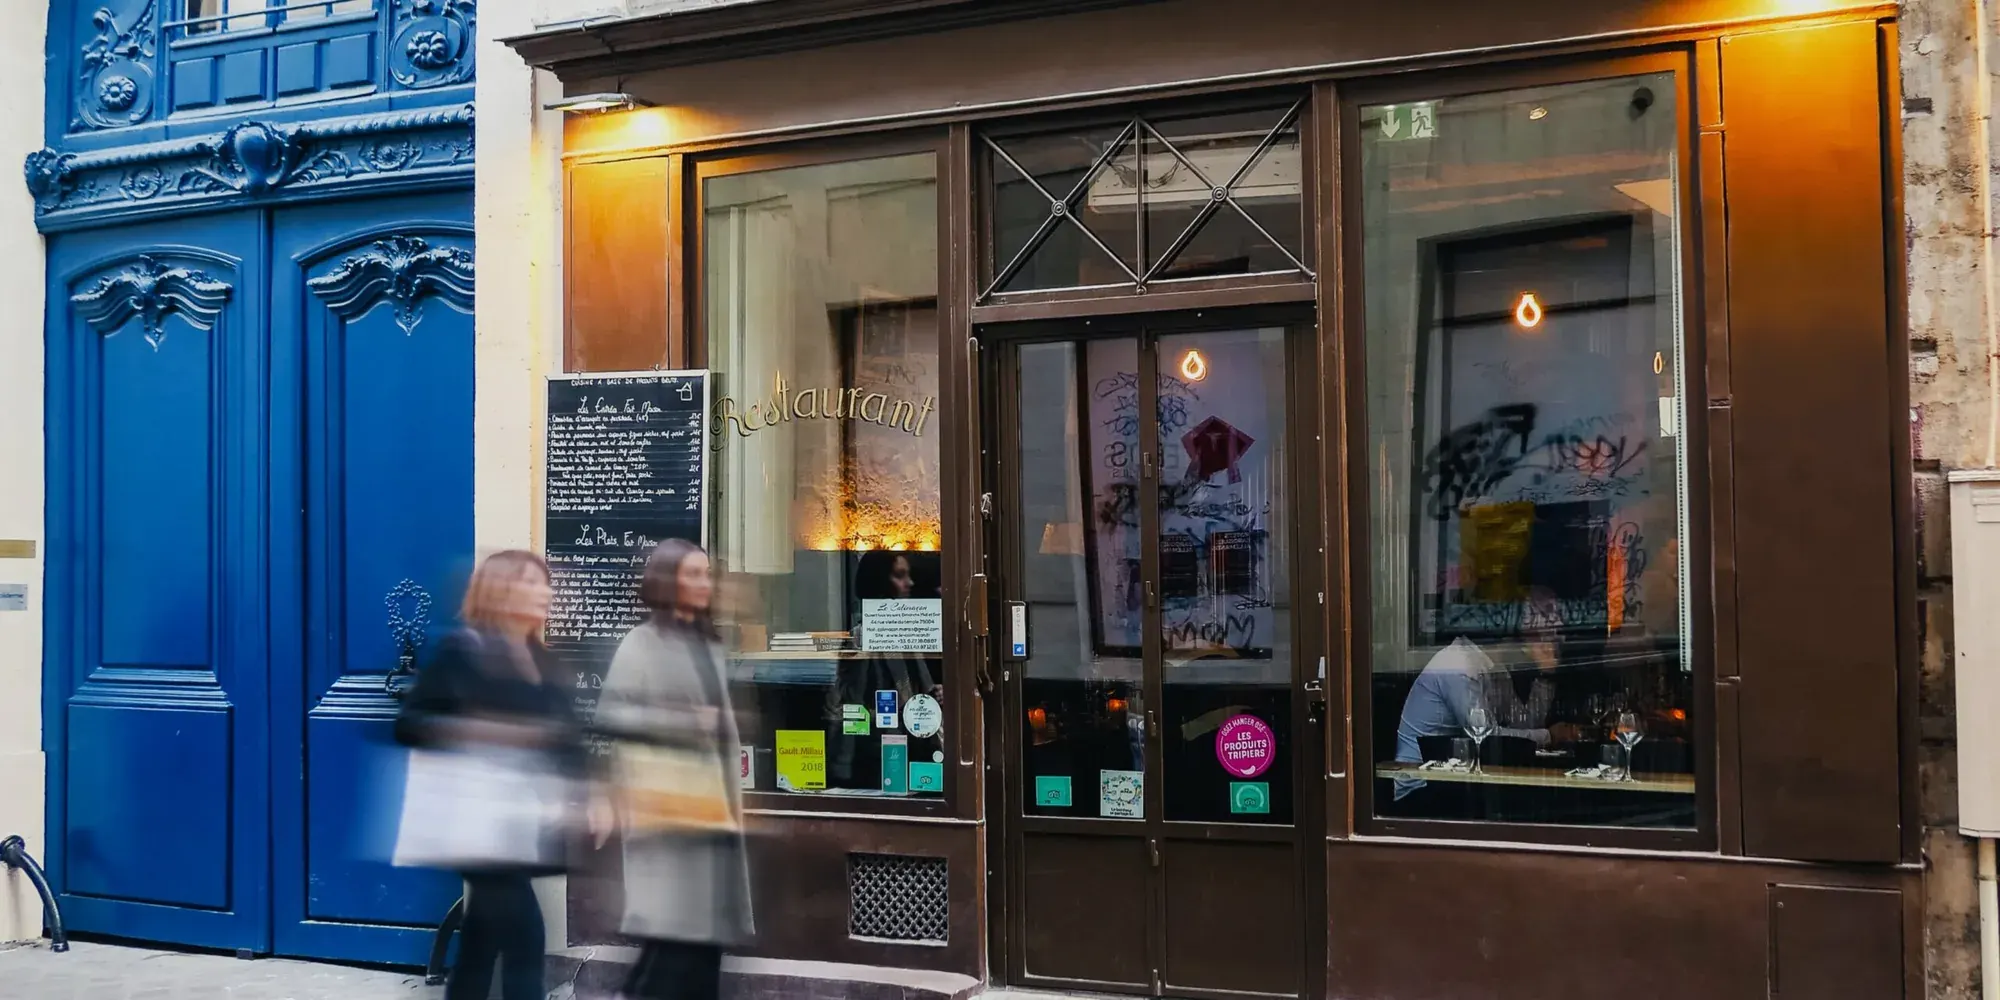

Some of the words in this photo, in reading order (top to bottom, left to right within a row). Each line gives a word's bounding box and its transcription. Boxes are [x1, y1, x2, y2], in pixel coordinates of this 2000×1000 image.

[709, 378, 934, 451] Restaurant
[575, 524, 594, 546] Les
[878, 603, 888, 612] Le
[1222, 724, 1234, 736] OSEZ
[1232, 718, 1254, 728] MANGER
[1237, 732, 1252, 741] LES
[1224, 739, 1267, 752] PRODUITS
[1228, 749, 1266, 760] TRIPIERS
[801, 762, 823, 772] 2018
